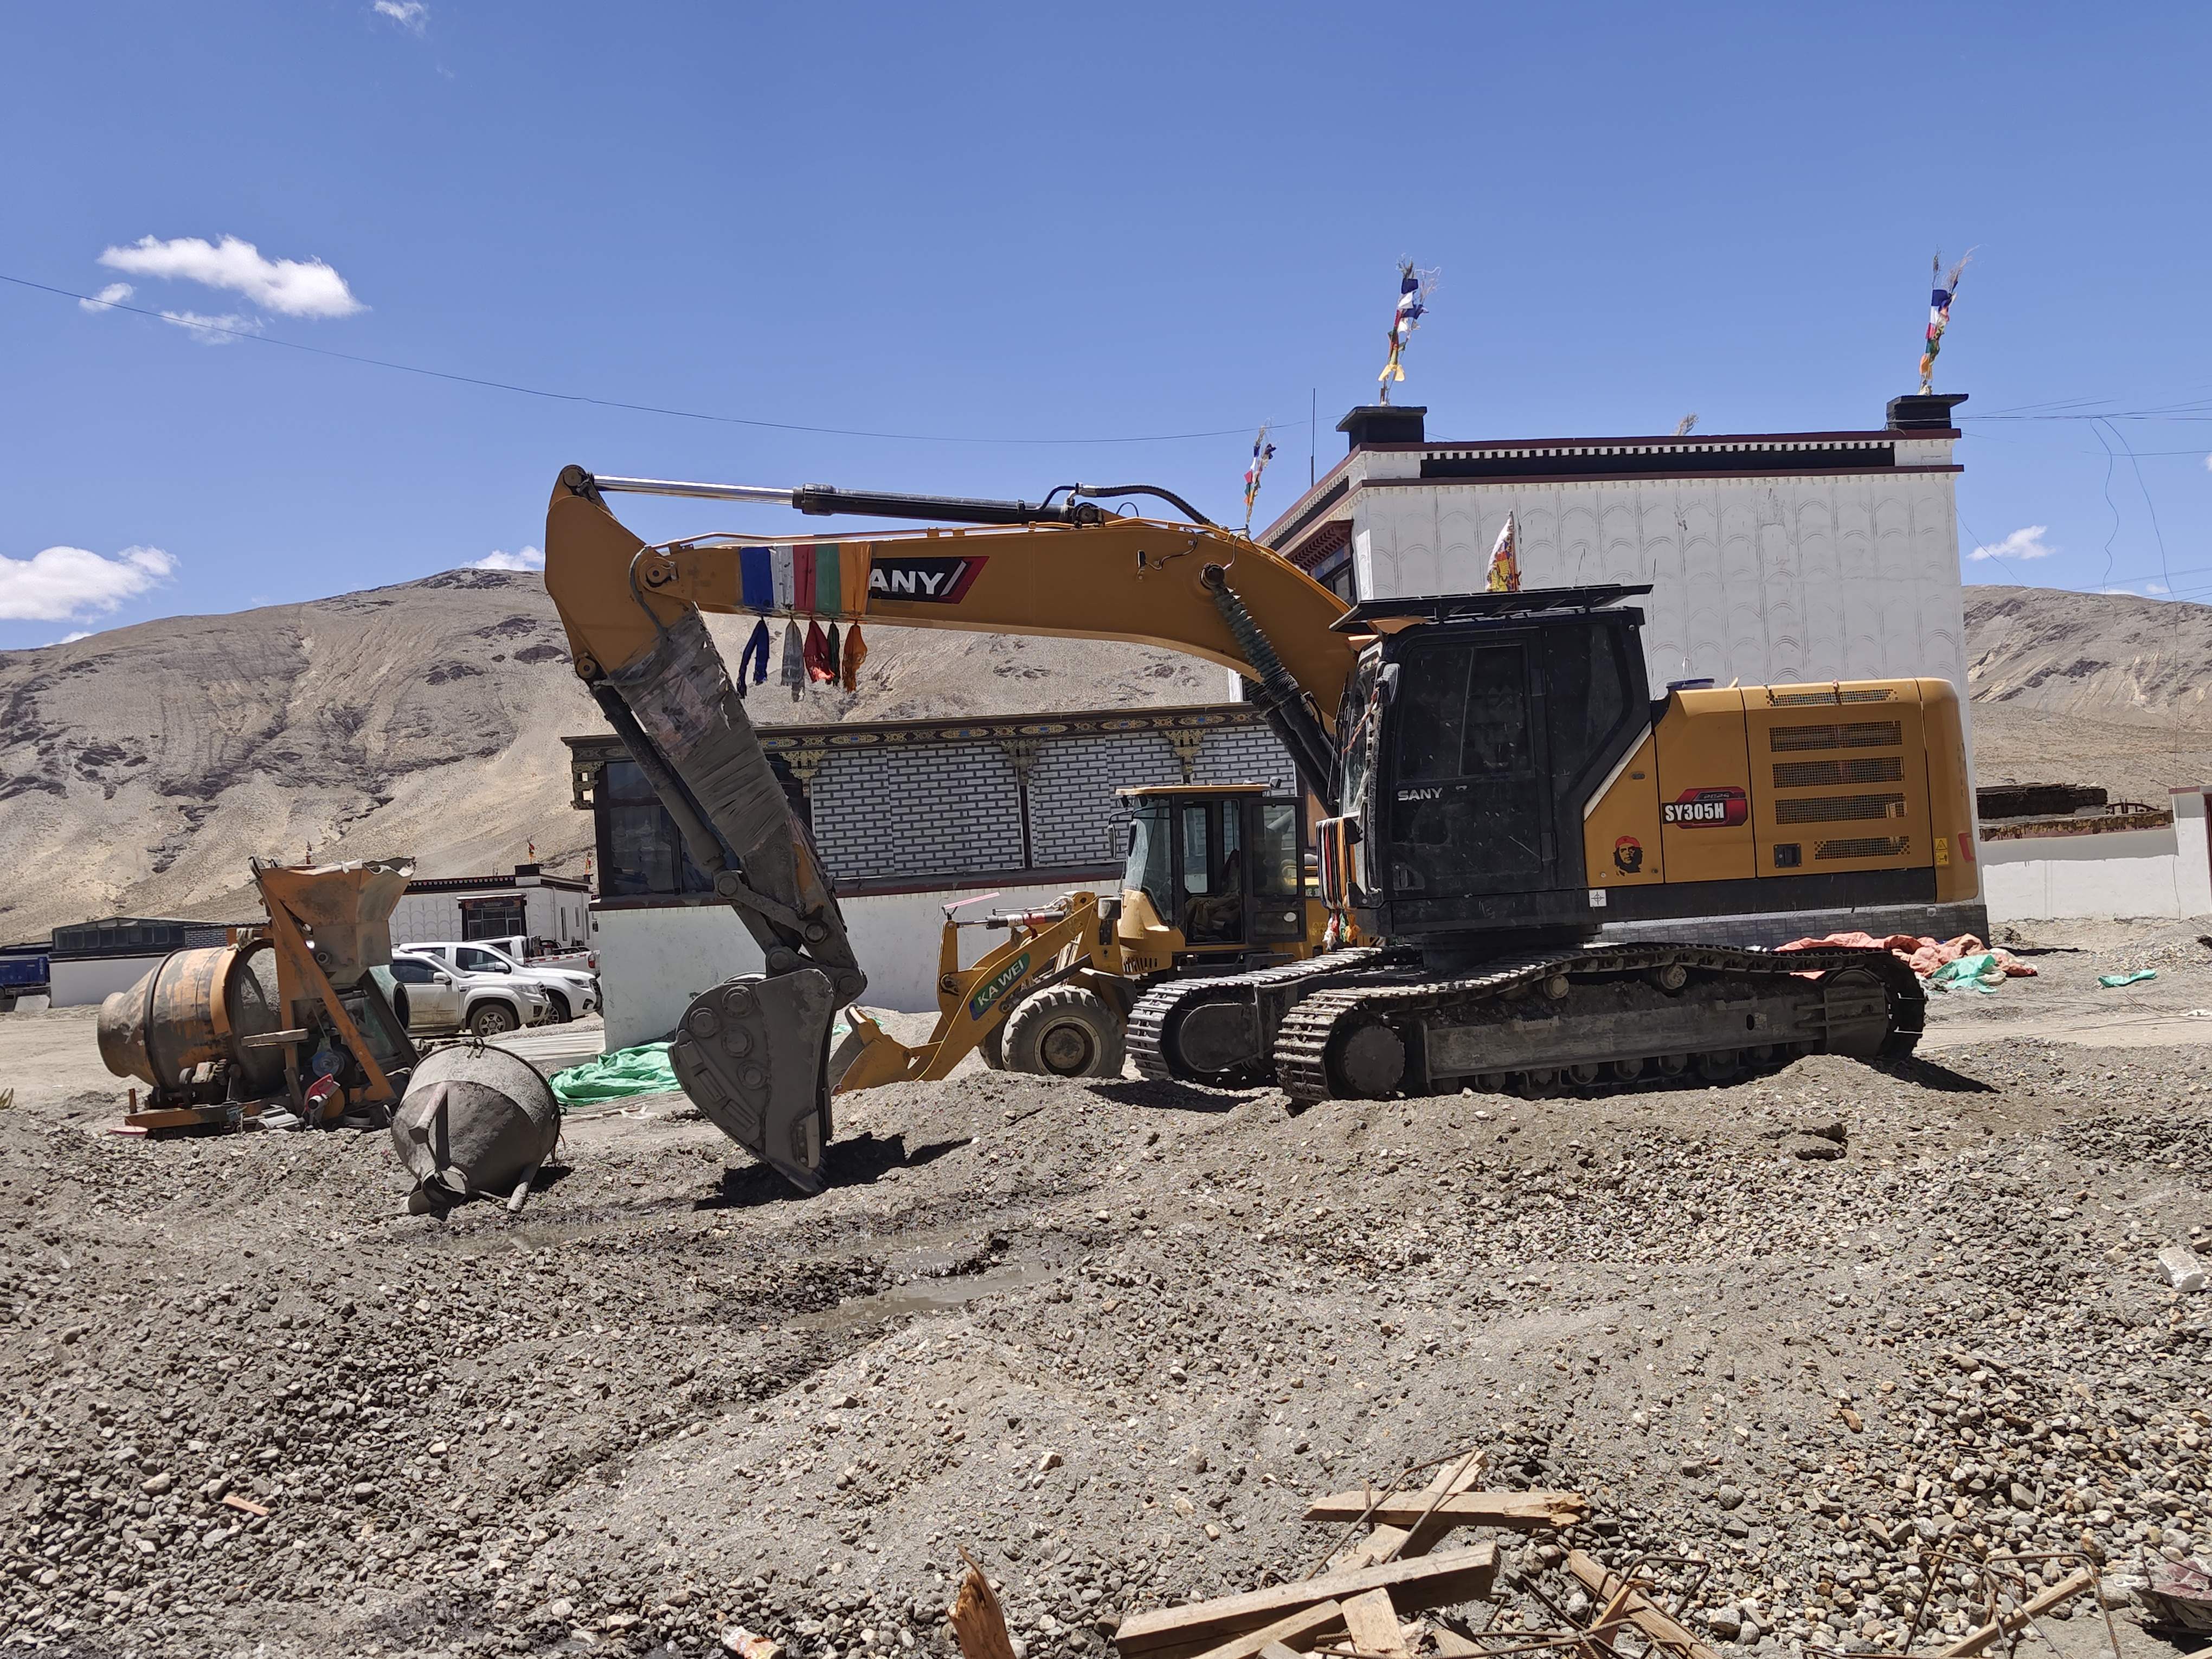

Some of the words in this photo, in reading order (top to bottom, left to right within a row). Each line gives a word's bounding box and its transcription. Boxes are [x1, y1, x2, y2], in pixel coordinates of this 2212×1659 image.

[869, 569, 945, 595] ANY
[1398, 787, 1443, 801] SANY
[1665, 802, 1725, 821] SY305H
